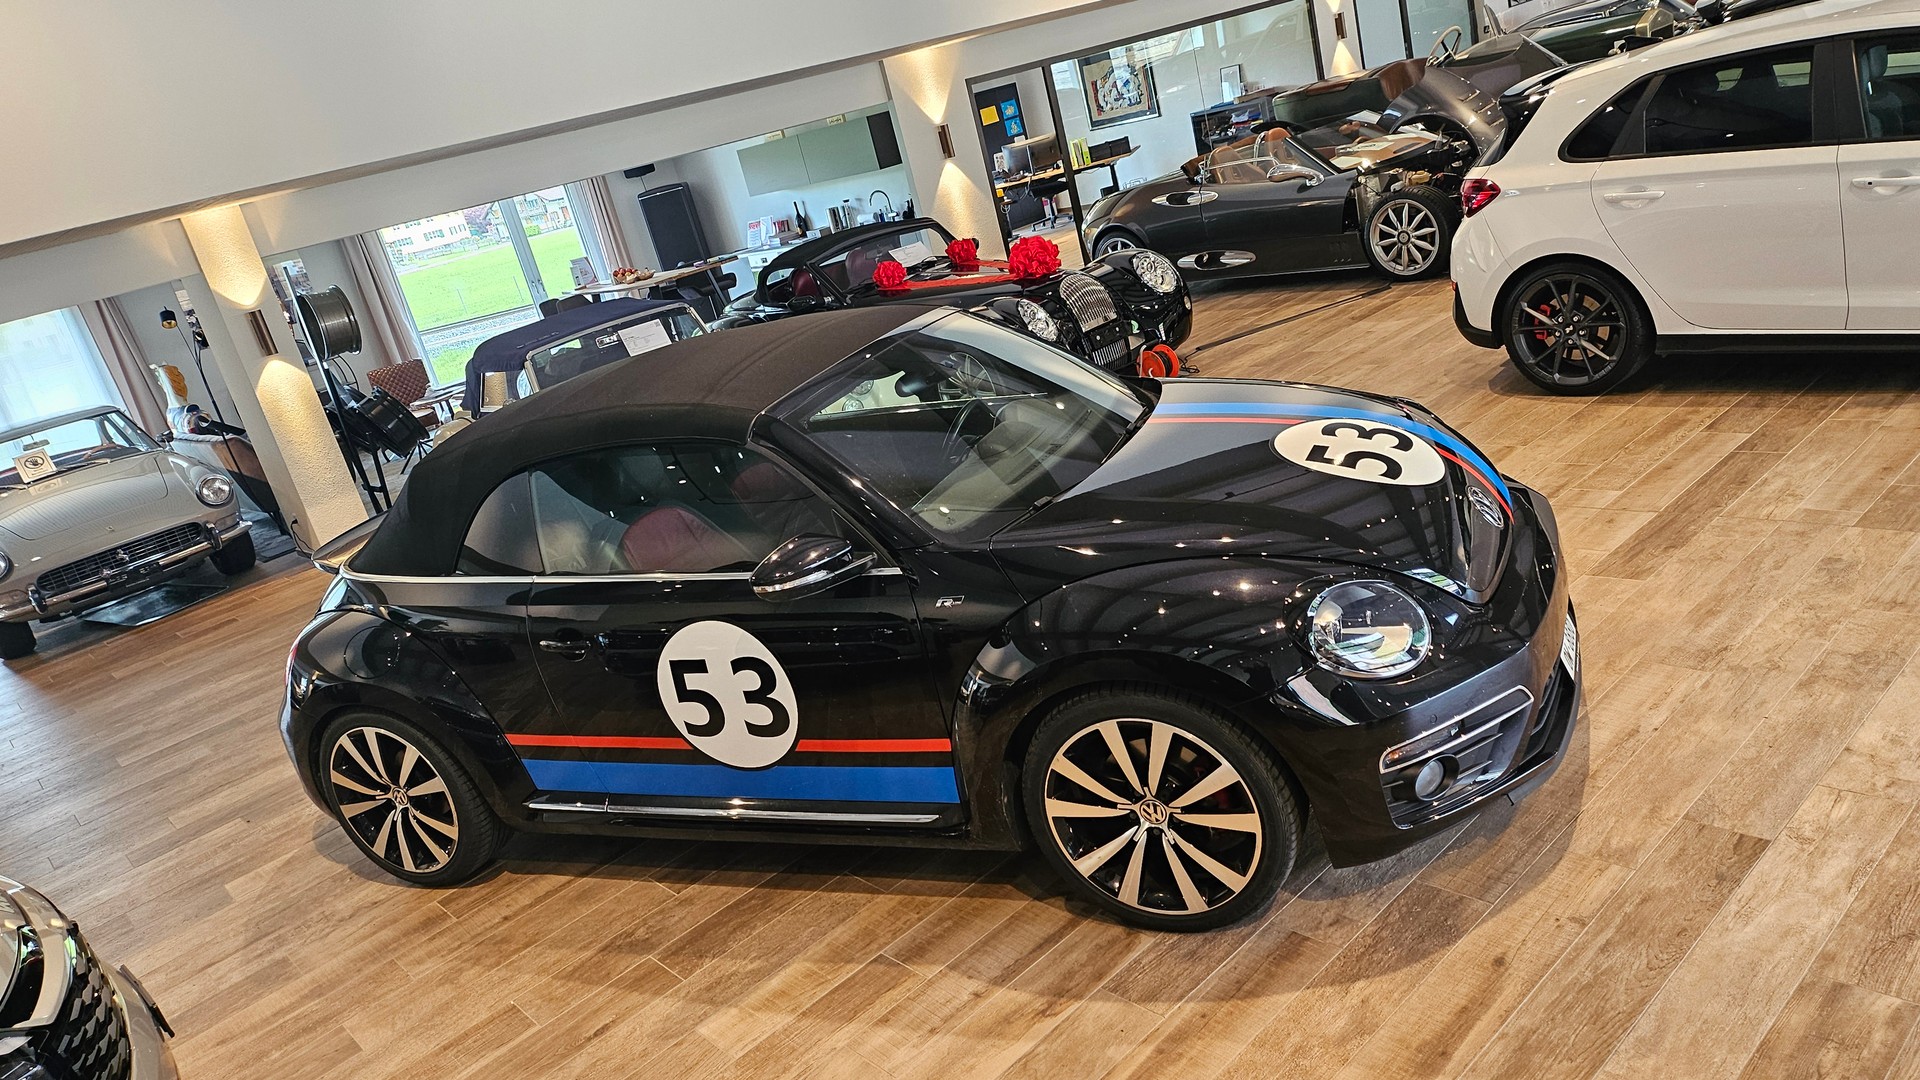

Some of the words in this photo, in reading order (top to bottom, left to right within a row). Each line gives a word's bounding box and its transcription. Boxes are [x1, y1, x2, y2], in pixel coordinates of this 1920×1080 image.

[1305, 422, 1414, 481] 53
[668, 656, 790, 738] 53
[1140, 800, 1167, 825] VW
